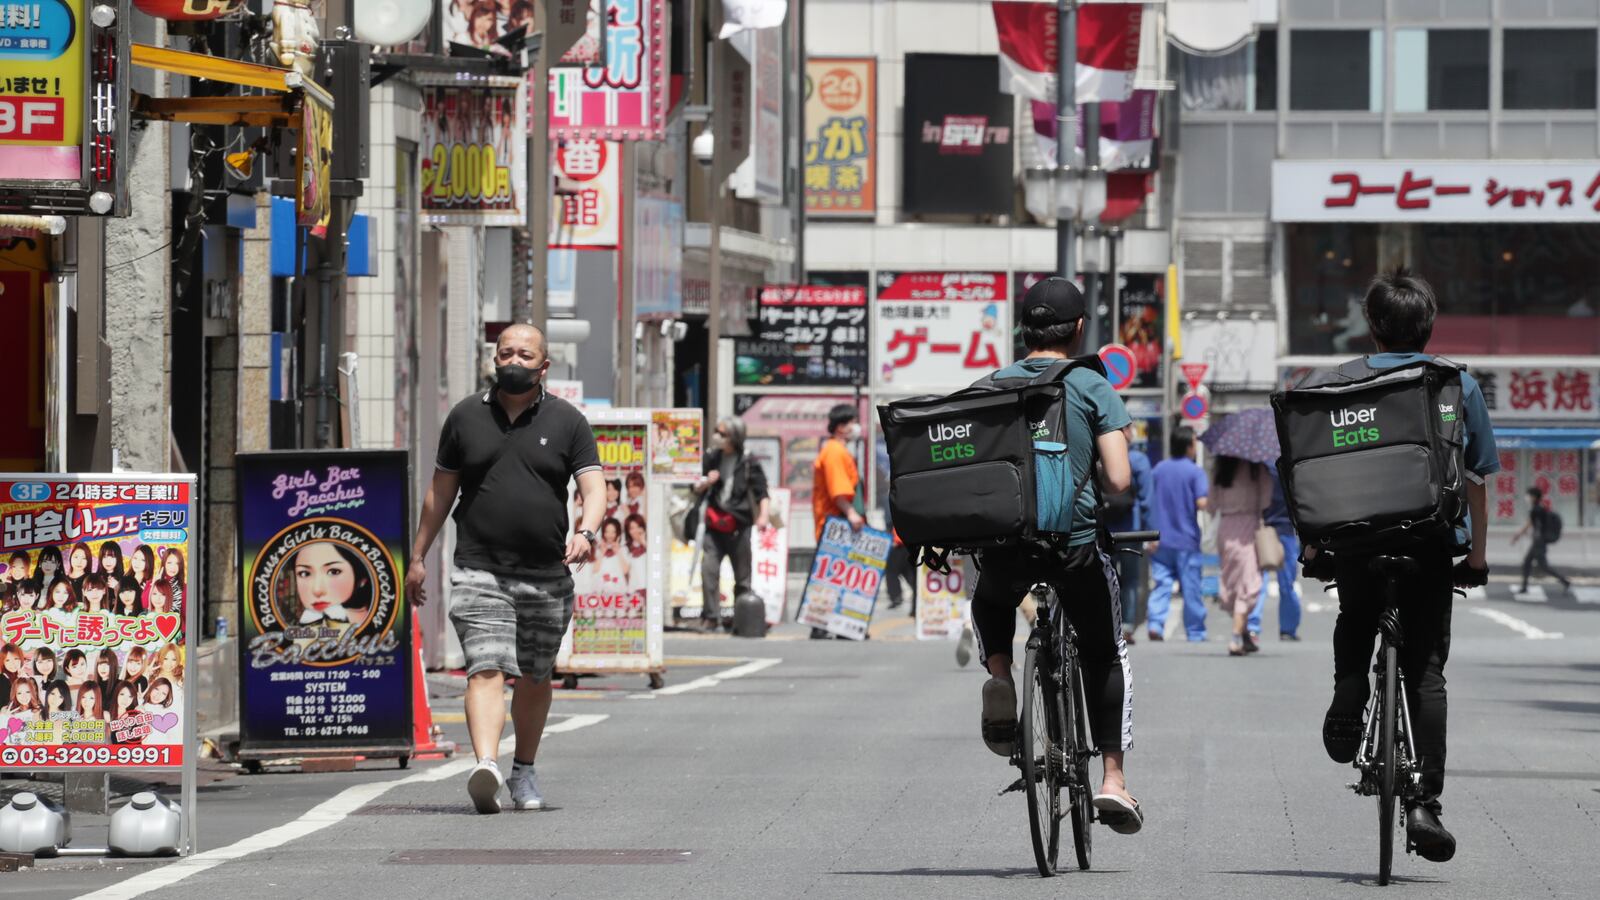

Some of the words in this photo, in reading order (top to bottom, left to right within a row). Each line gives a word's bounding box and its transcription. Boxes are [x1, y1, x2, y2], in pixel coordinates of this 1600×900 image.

[0, 4, 41, 28] 料!
[1324, 171, 1471, 209] コーヒー
[887, 326, 1001, 369] ゲーム
[1330, 407, 1377, 427] Uber
[1438, 404, 1454, 414] Uber
[1441, 413, 1457, 422] Eats
[927, 423, 973, 443] Uber
[1332, 426, 1380, 447] Eats
[930, 442, 976, 463] Eats
[18, 484, 43, 499] 3F
[55, 484, 178, 500] 24時まで営業!!
[272, 469, 317, 499] Girls
[319, 466, 361, 492] Bar
[287, 484, 365, 517] Bacchus
[141, 510, 186, 527] キラリ
[255, 553, 281, 628] Bacchus
[283, 524, 327, 551] Girls
[329, 524, 365, 547] Bar
[366, 546, 396, 629] Bacchus
[814, 555, 879, 596] 1200
[926, 570, 964, 594] 60
[249, 623, 400, 668] Bacchus
[304, 671, 325, 680] OPEN
[328, 670, 350, 679] 17:00
[362, 669, 381, 679] 5:00
[305, 682, 347, 693] SYSTEM
[62, 720, 105, 730] 2,000円
[300, 715, 316, 724] TAX
[62, 732, 105, 742] 2,000円
[20, 747, 170, 764] 03-3209-9991
